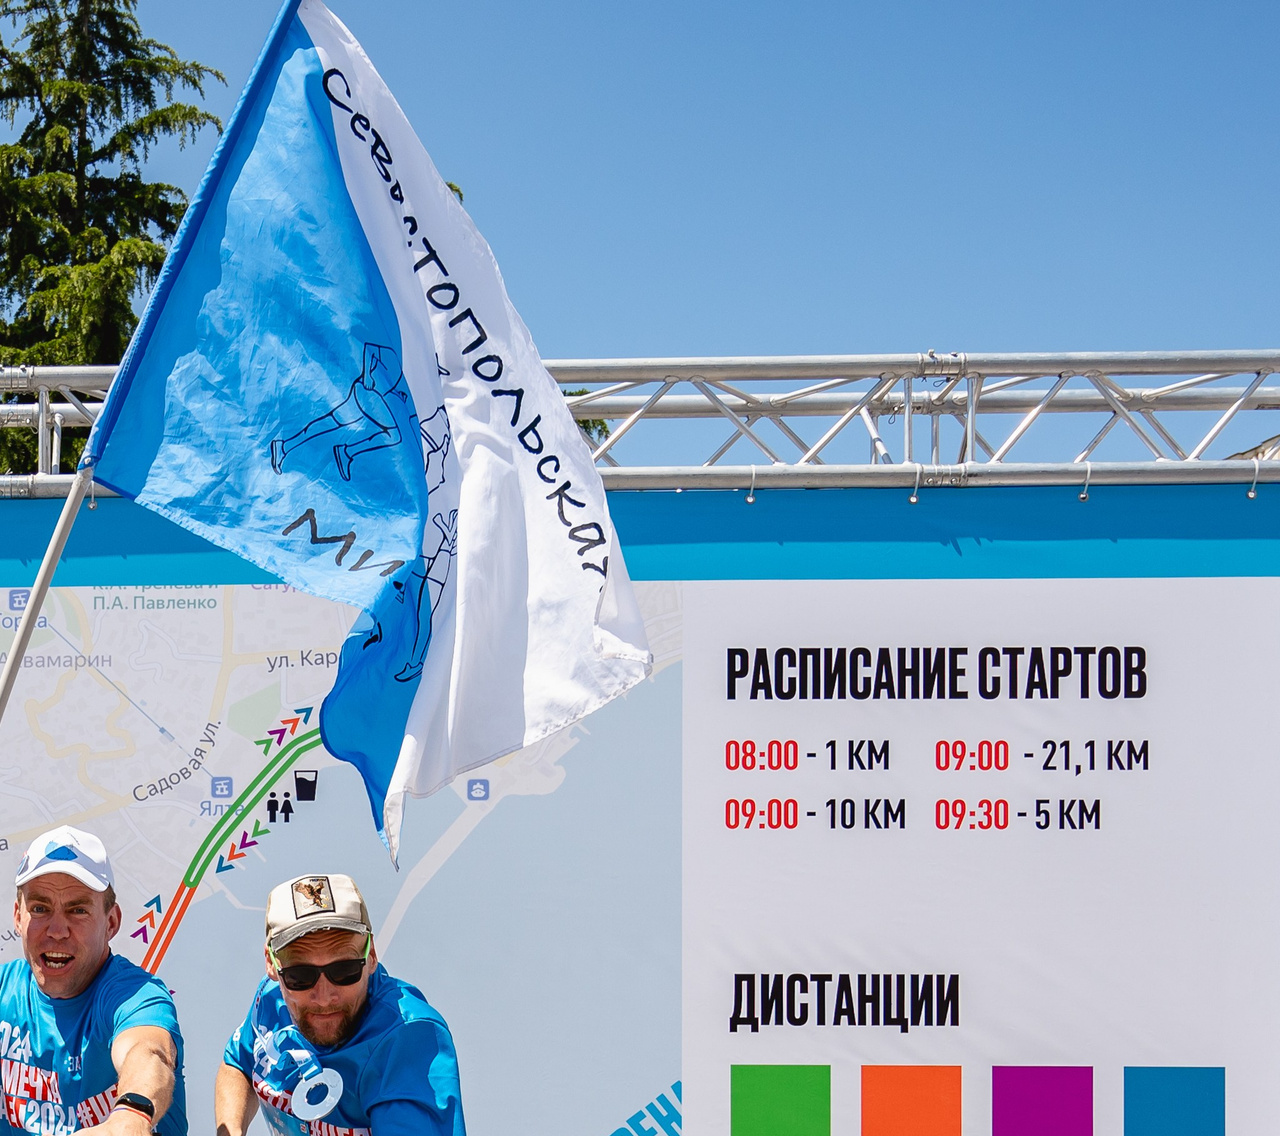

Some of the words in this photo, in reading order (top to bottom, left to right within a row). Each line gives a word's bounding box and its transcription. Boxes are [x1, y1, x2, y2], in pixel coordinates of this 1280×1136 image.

[93, 596, 129, 610] П.А.
[133, 596, 218, 610] Павленко
[266, 655, 295, 673] ул.
[300, 649, 338, 668] Кар
[725, 647, 969, 701] РАСПИСАНИЕ
[977, 646, 1148, 700] СТАРТОВ
[132, 747, 207, 801] Садовая
[199, 721, 222, 747] ул.
[724, 740, 799, 771] 08:00
[825, 740, 839, 770] 1
[847, 740, 891, 771] КМ
[934, 740, 1010, 771] 09:00
[1041, 740, 1097, 776] 21,1
[1106, 740, 1150, 771] КМ
[724, 798, 799, 830] 09:00
[825, 799, 856, 829] 10
[863, 799, 907, 830] КМ
[934, 798, 1010, 830] 09:30
[1034, 799, 1052, 830] 5
[1058, 799, 1102, 830] КМ
[729, 973, 961, 1034] ДИСТАНЦИИ
[0, 1058, 64, 1105] МЕЧТА
